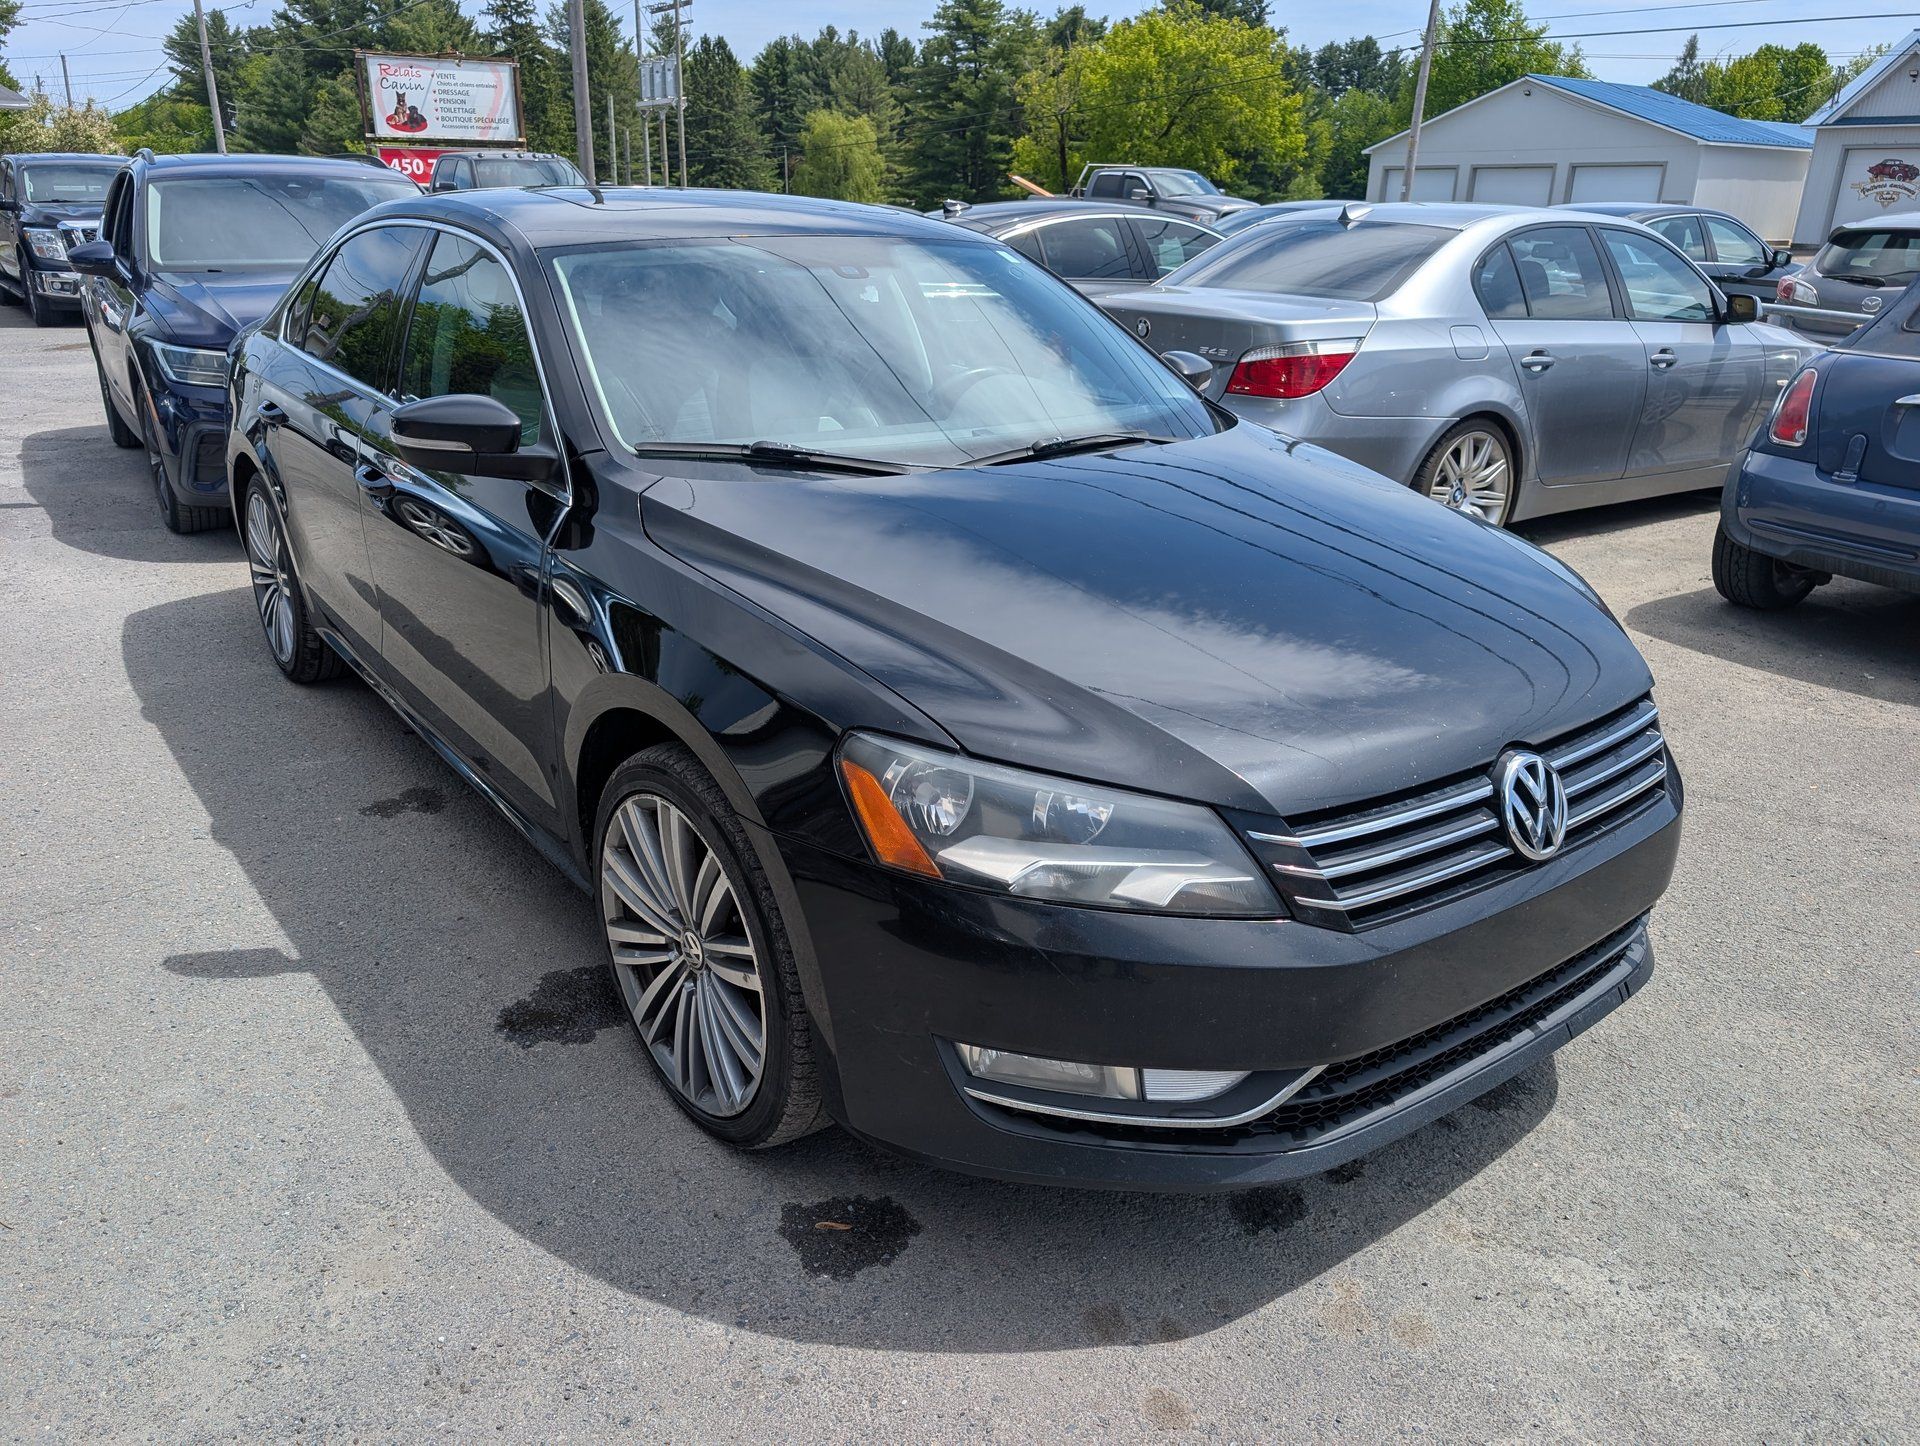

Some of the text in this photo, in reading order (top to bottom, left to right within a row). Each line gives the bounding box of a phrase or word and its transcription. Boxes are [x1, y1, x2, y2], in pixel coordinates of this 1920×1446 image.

[377, 63, 422, 77] Relais
[380, 77, 424, 91] Canin
[437, 89, 470, 97] DRESSAGE
[439, 107, 477, 115] TOILETTAGE
[390, 158, 425, 175] 450
